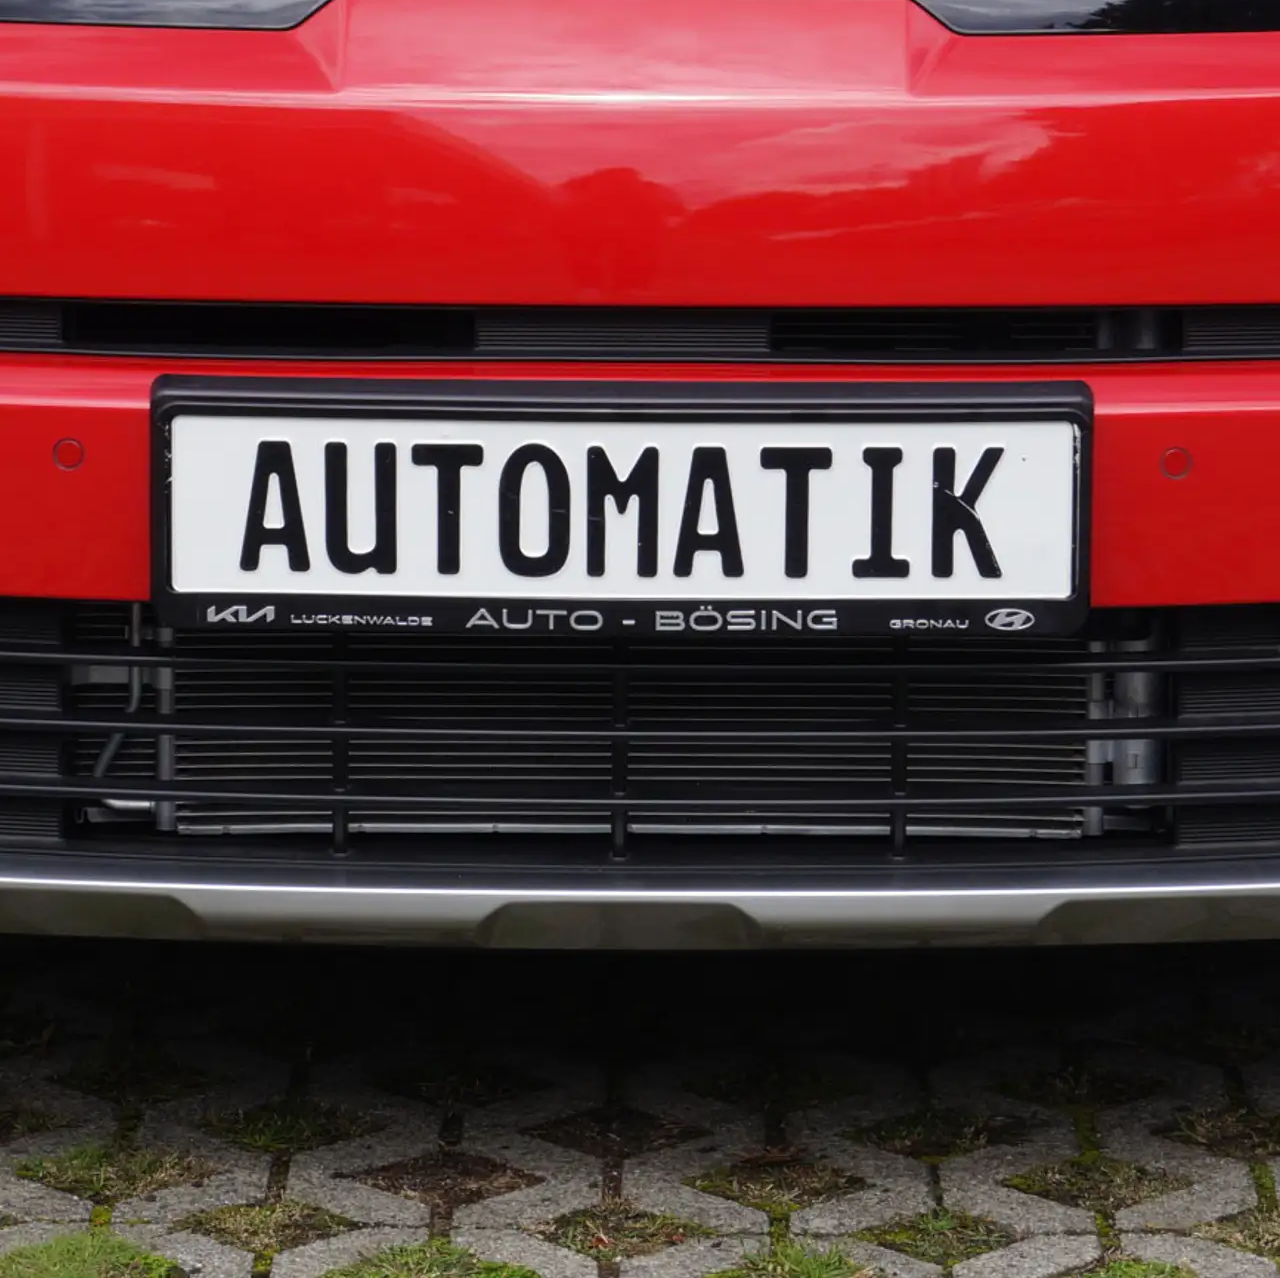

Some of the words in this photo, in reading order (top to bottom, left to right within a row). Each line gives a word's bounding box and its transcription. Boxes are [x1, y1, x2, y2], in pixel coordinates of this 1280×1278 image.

[239, 440, 1005, 579] AUTOMATIK
[206, 605, 276, 623] KIA
[290, 613, 433, 627] LUCKENWALDE
[465, 607, 604, 631] AUTO
[655, 605, 838, 631] BÖSING
[889, 617, 970, 630] GRONAU
